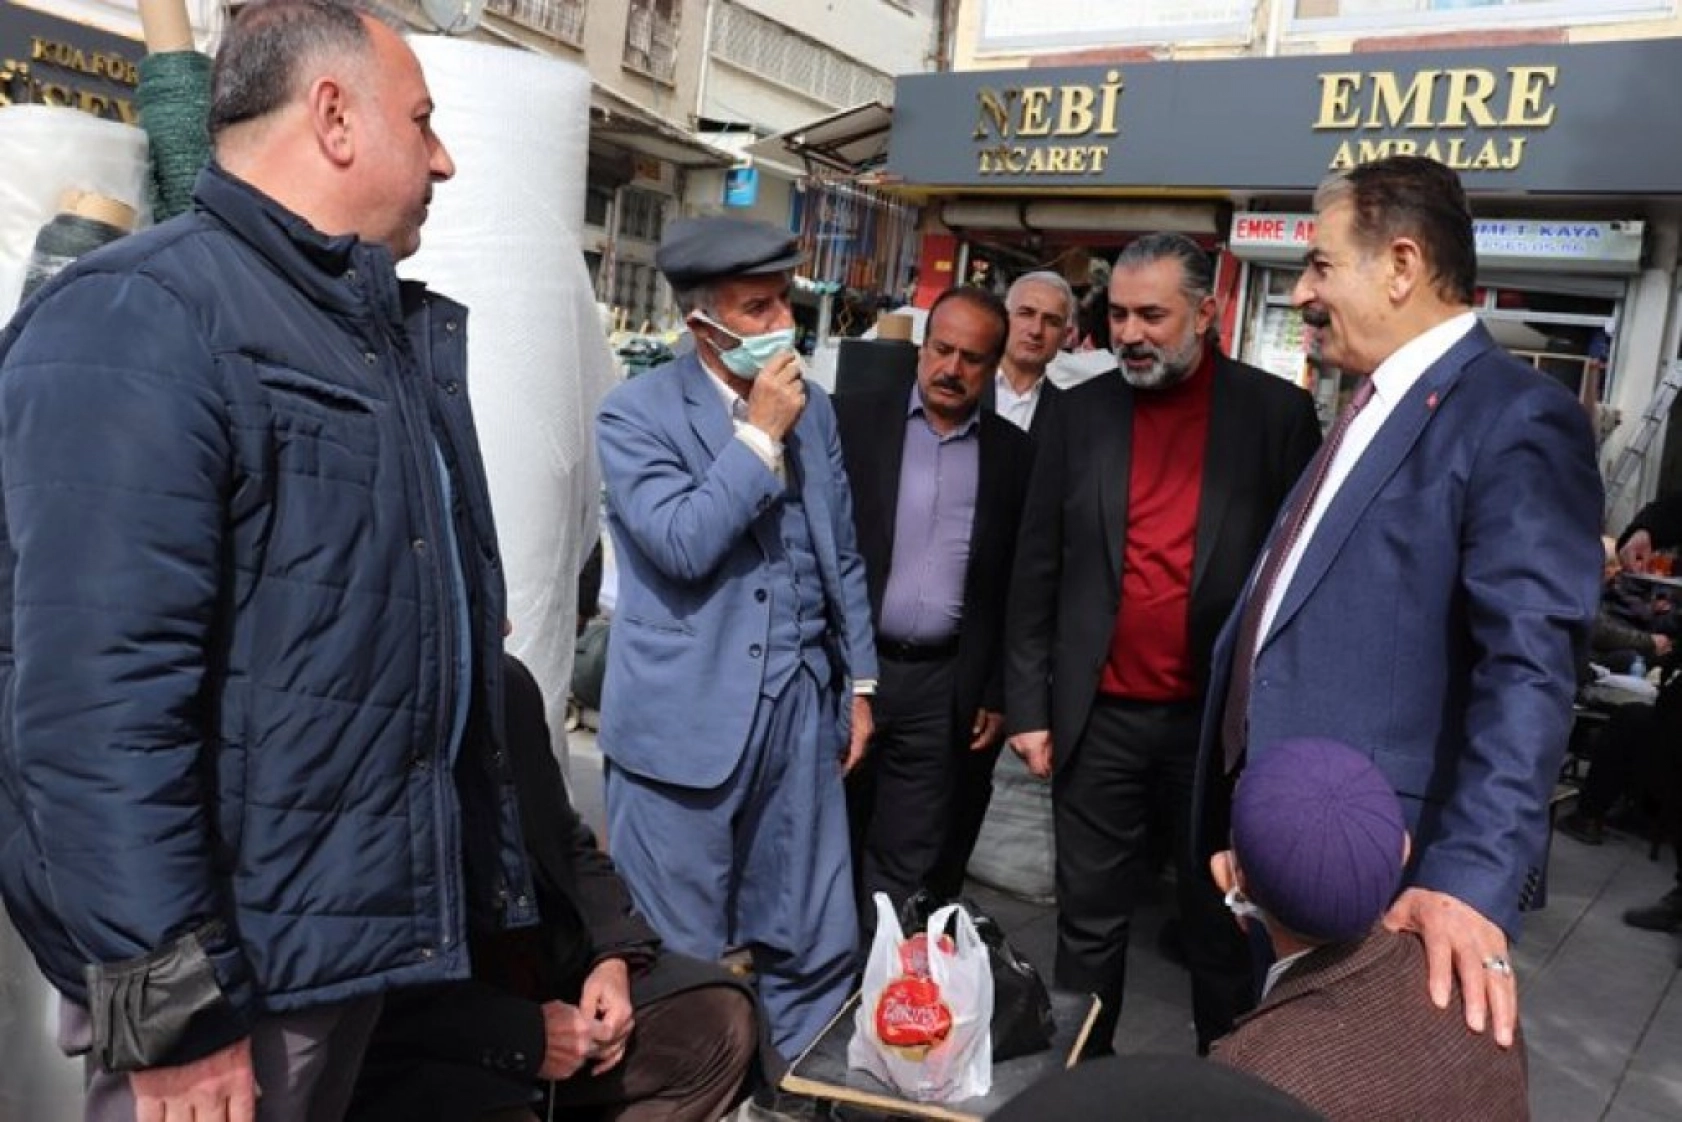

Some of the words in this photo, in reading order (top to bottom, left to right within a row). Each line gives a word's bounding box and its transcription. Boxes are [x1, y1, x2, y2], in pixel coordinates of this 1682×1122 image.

[973, 70, 1124, 138] NEBİ
[1312, 66, 1558, 129] EMRE
[1236, 219, 1285, 240] EMRE
